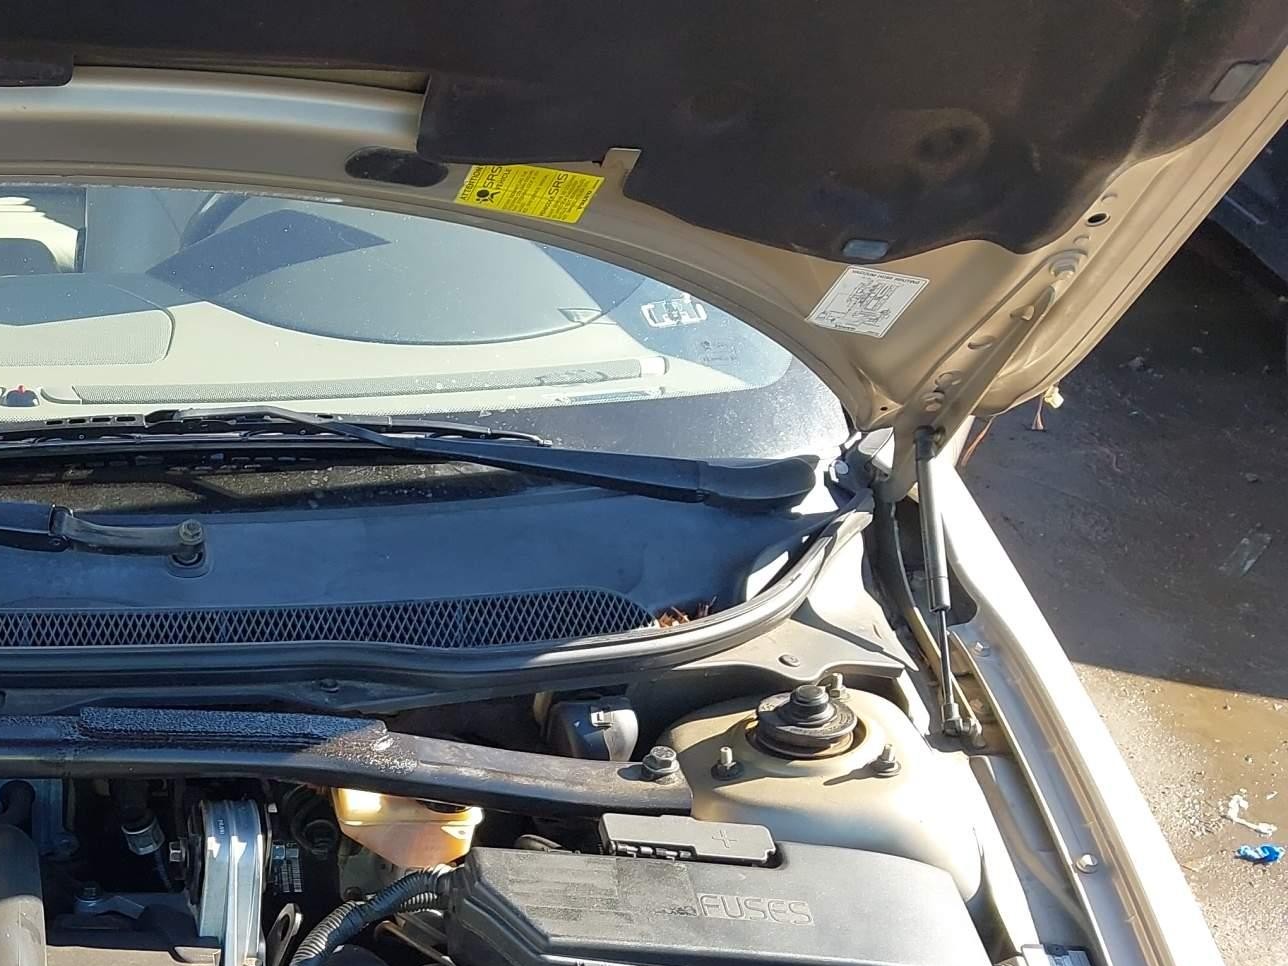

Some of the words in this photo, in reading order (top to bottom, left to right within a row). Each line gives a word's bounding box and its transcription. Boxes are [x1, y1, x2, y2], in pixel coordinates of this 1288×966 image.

[461, 166, 482, 200] ATTENTION
[483, 166, 502, 188] SRS
[548, 173, 569, 196] SRS
[699, 894, 813, 925] FUSES
